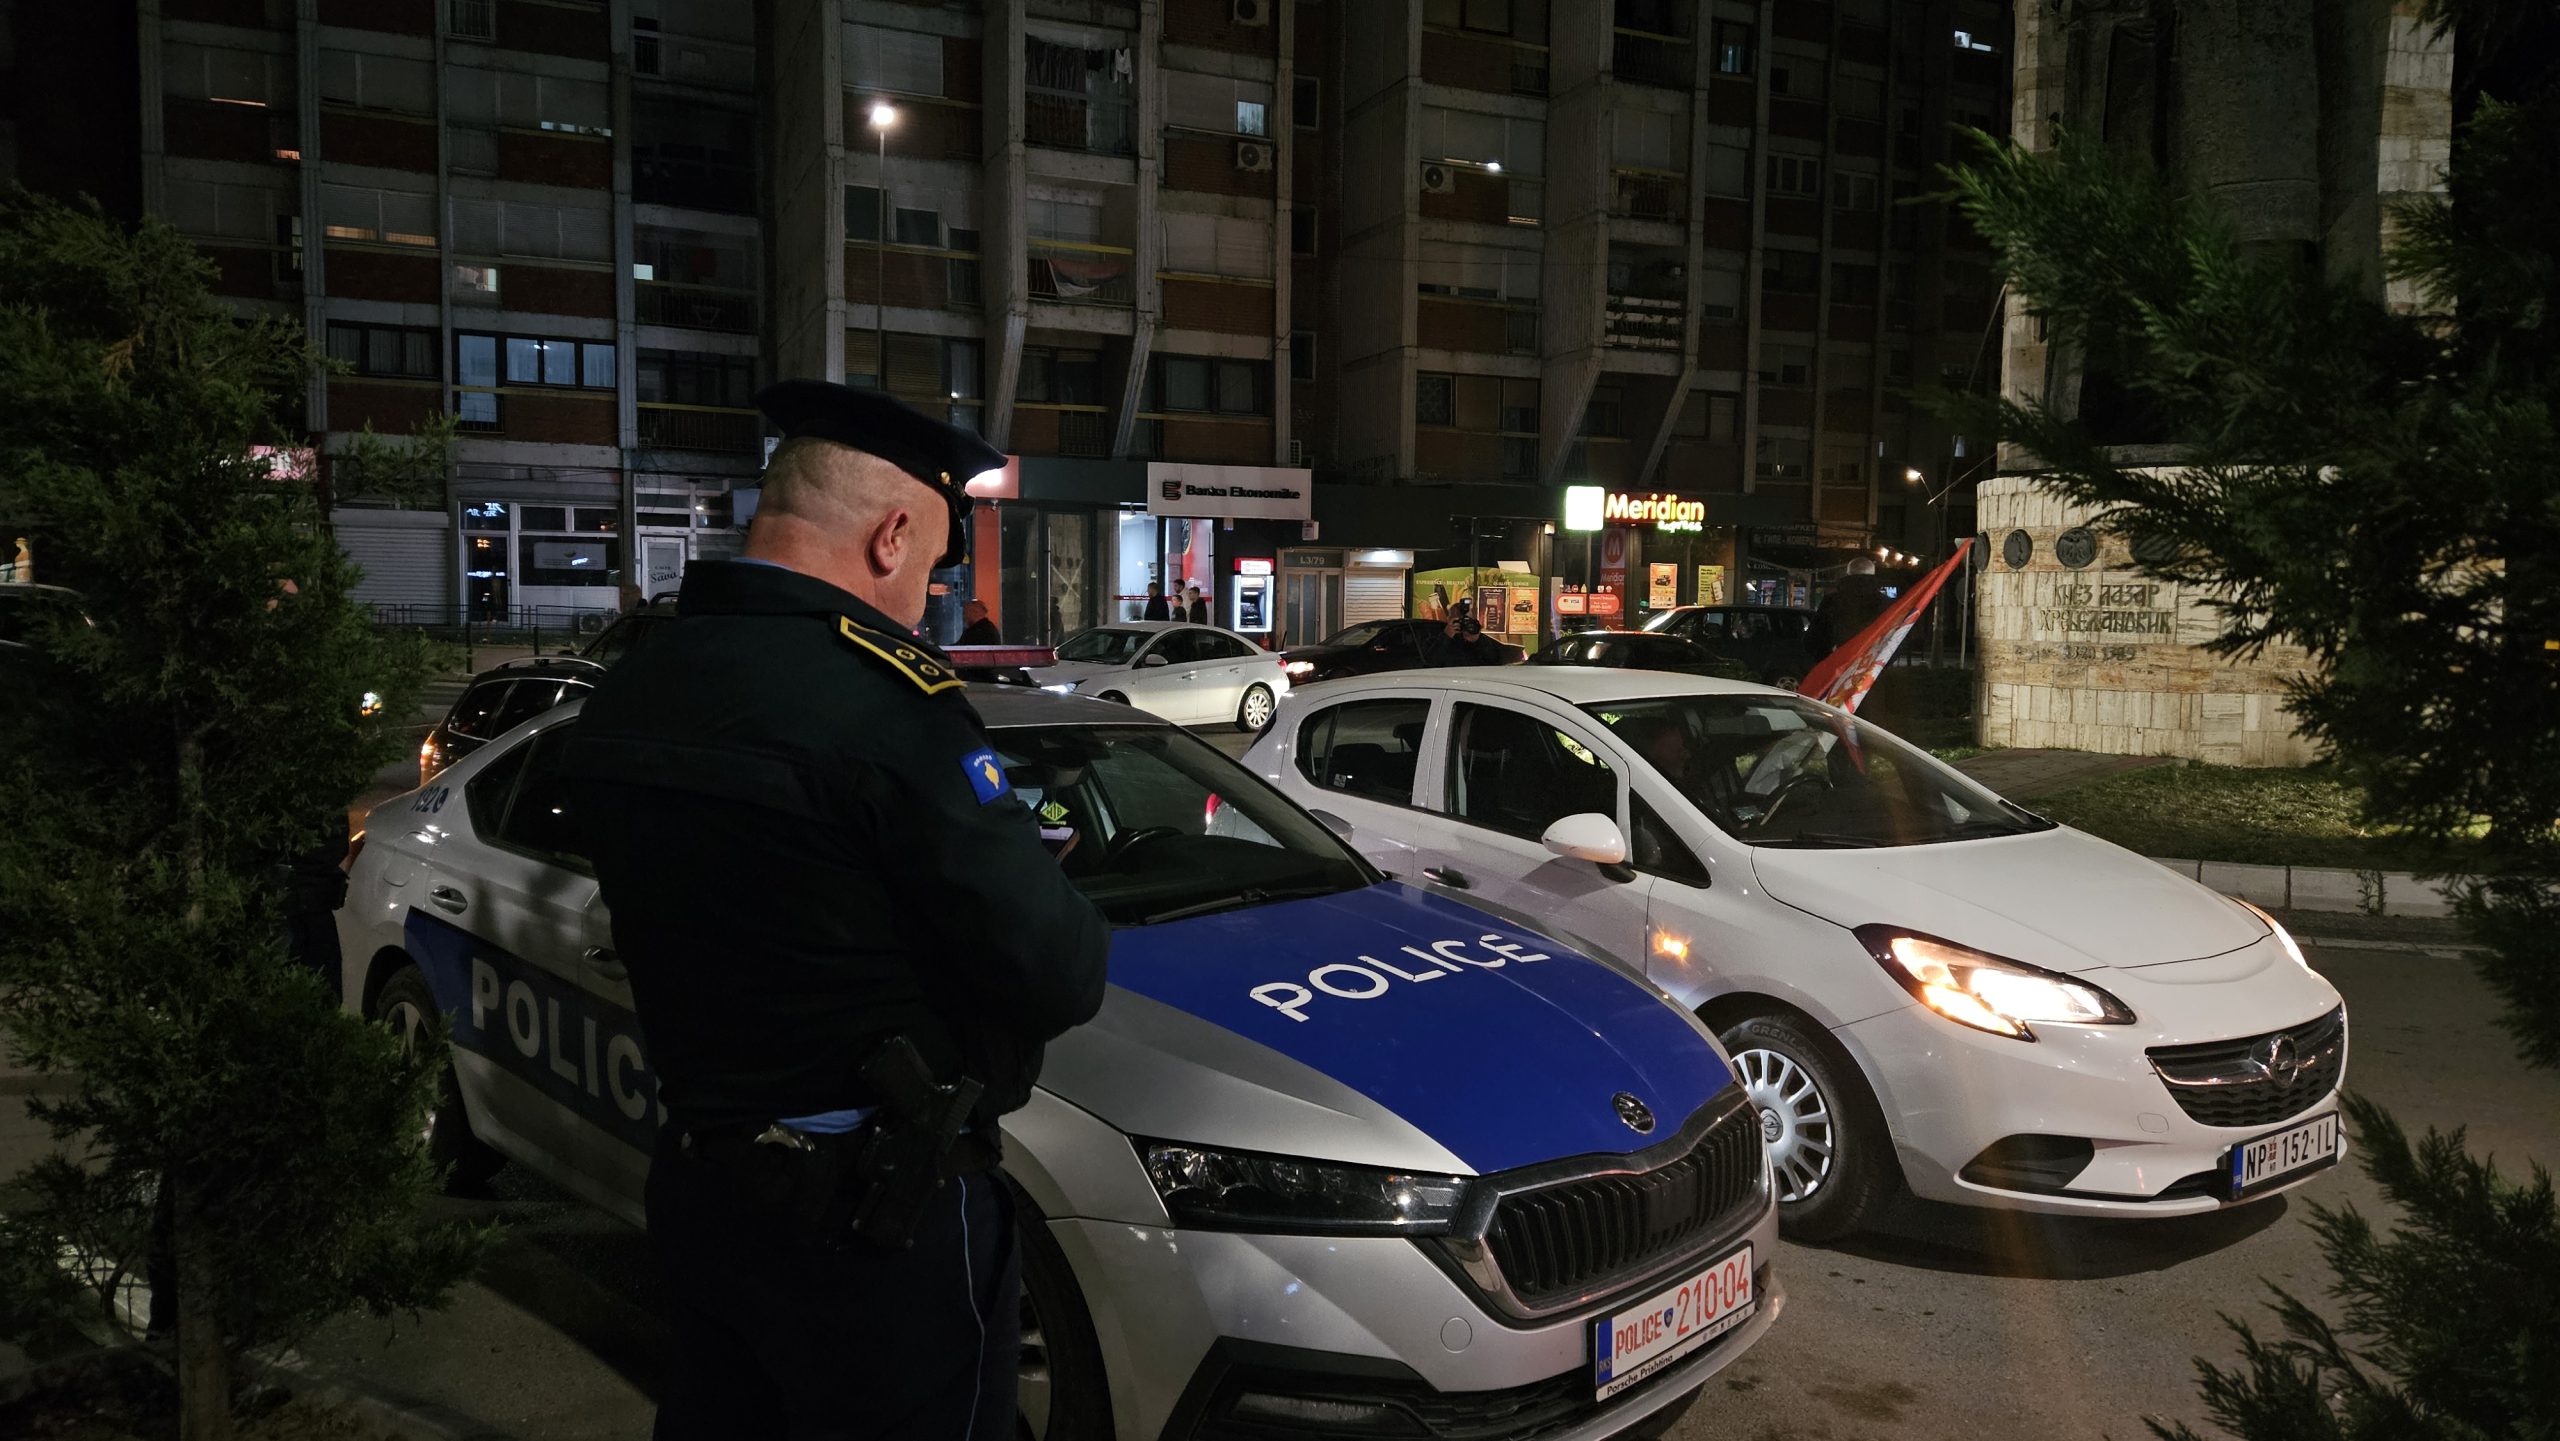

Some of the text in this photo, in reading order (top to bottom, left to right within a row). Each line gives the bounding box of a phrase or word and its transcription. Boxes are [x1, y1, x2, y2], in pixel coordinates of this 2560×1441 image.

[1186, 485, 1300, 499] Banka Ekonomike
[1606, 494, 1704, 521] Meridian
[1300, 556, 1325, 565] L3/79
[1250, 934, 1550, 1022] POLICE
[472, 957, 668, 1128] POLIC
[2246, 1144, 2267, 1180] NP
[1616, 1309, 1663, 1360] POLICE
[1676, 1254, 1749, 1337] 210-04
[1607, 1354, 1673, 1396] Porsche Prishtina
